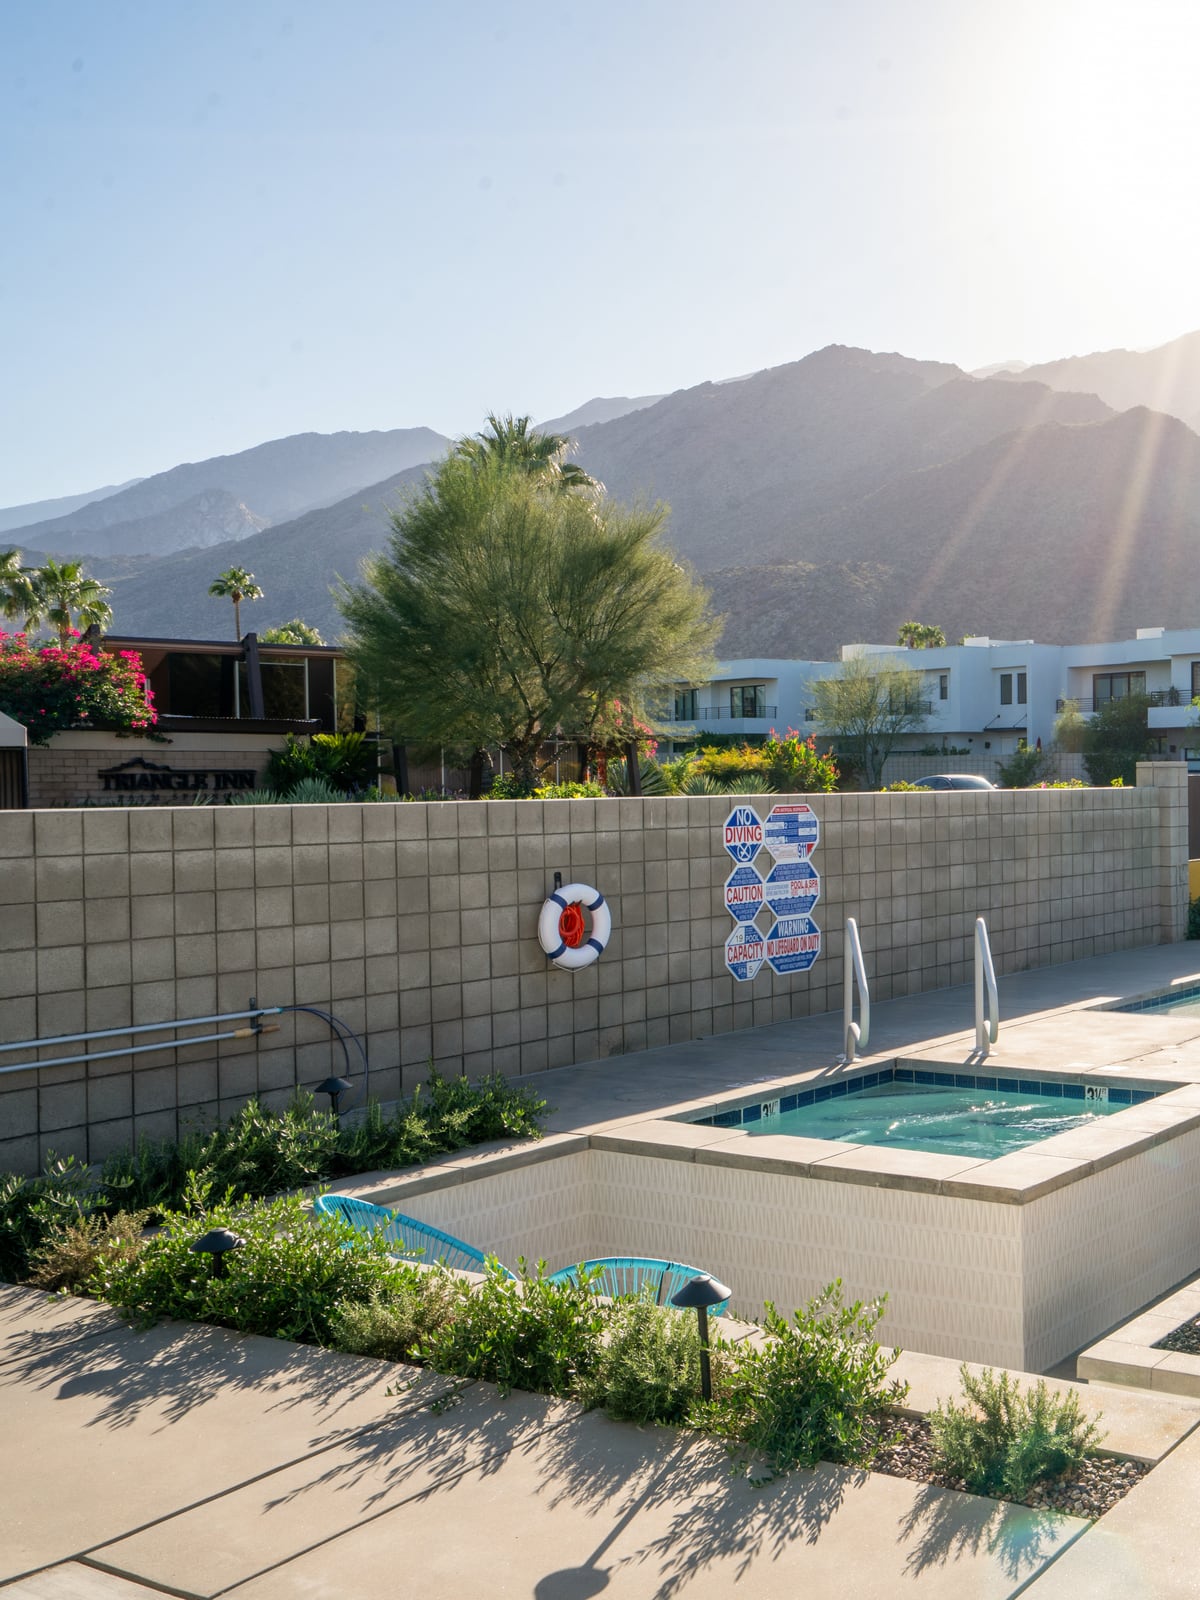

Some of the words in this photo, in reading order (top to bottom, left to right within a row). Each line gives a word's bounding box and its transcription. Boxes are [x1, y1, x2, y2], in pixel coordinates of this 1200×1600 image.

[98, 773, 208, 790] TRIANGLE
[214, 773, 256, 789] INN
[736, 809, 752, 826] NO
[725, 826, 762, 844] DIVING
[727, 885, 763, 903] CAUTION
[778, 919, 809, 938] WARNING
[735, 934, 744, 943] 19
[775, 937, 800, 956] LIFEGUARD
[800, 936, 808, 951] ON
[808, 934, 820, 951] DUTY
[728, 942, 764, 962] CAPACITY
